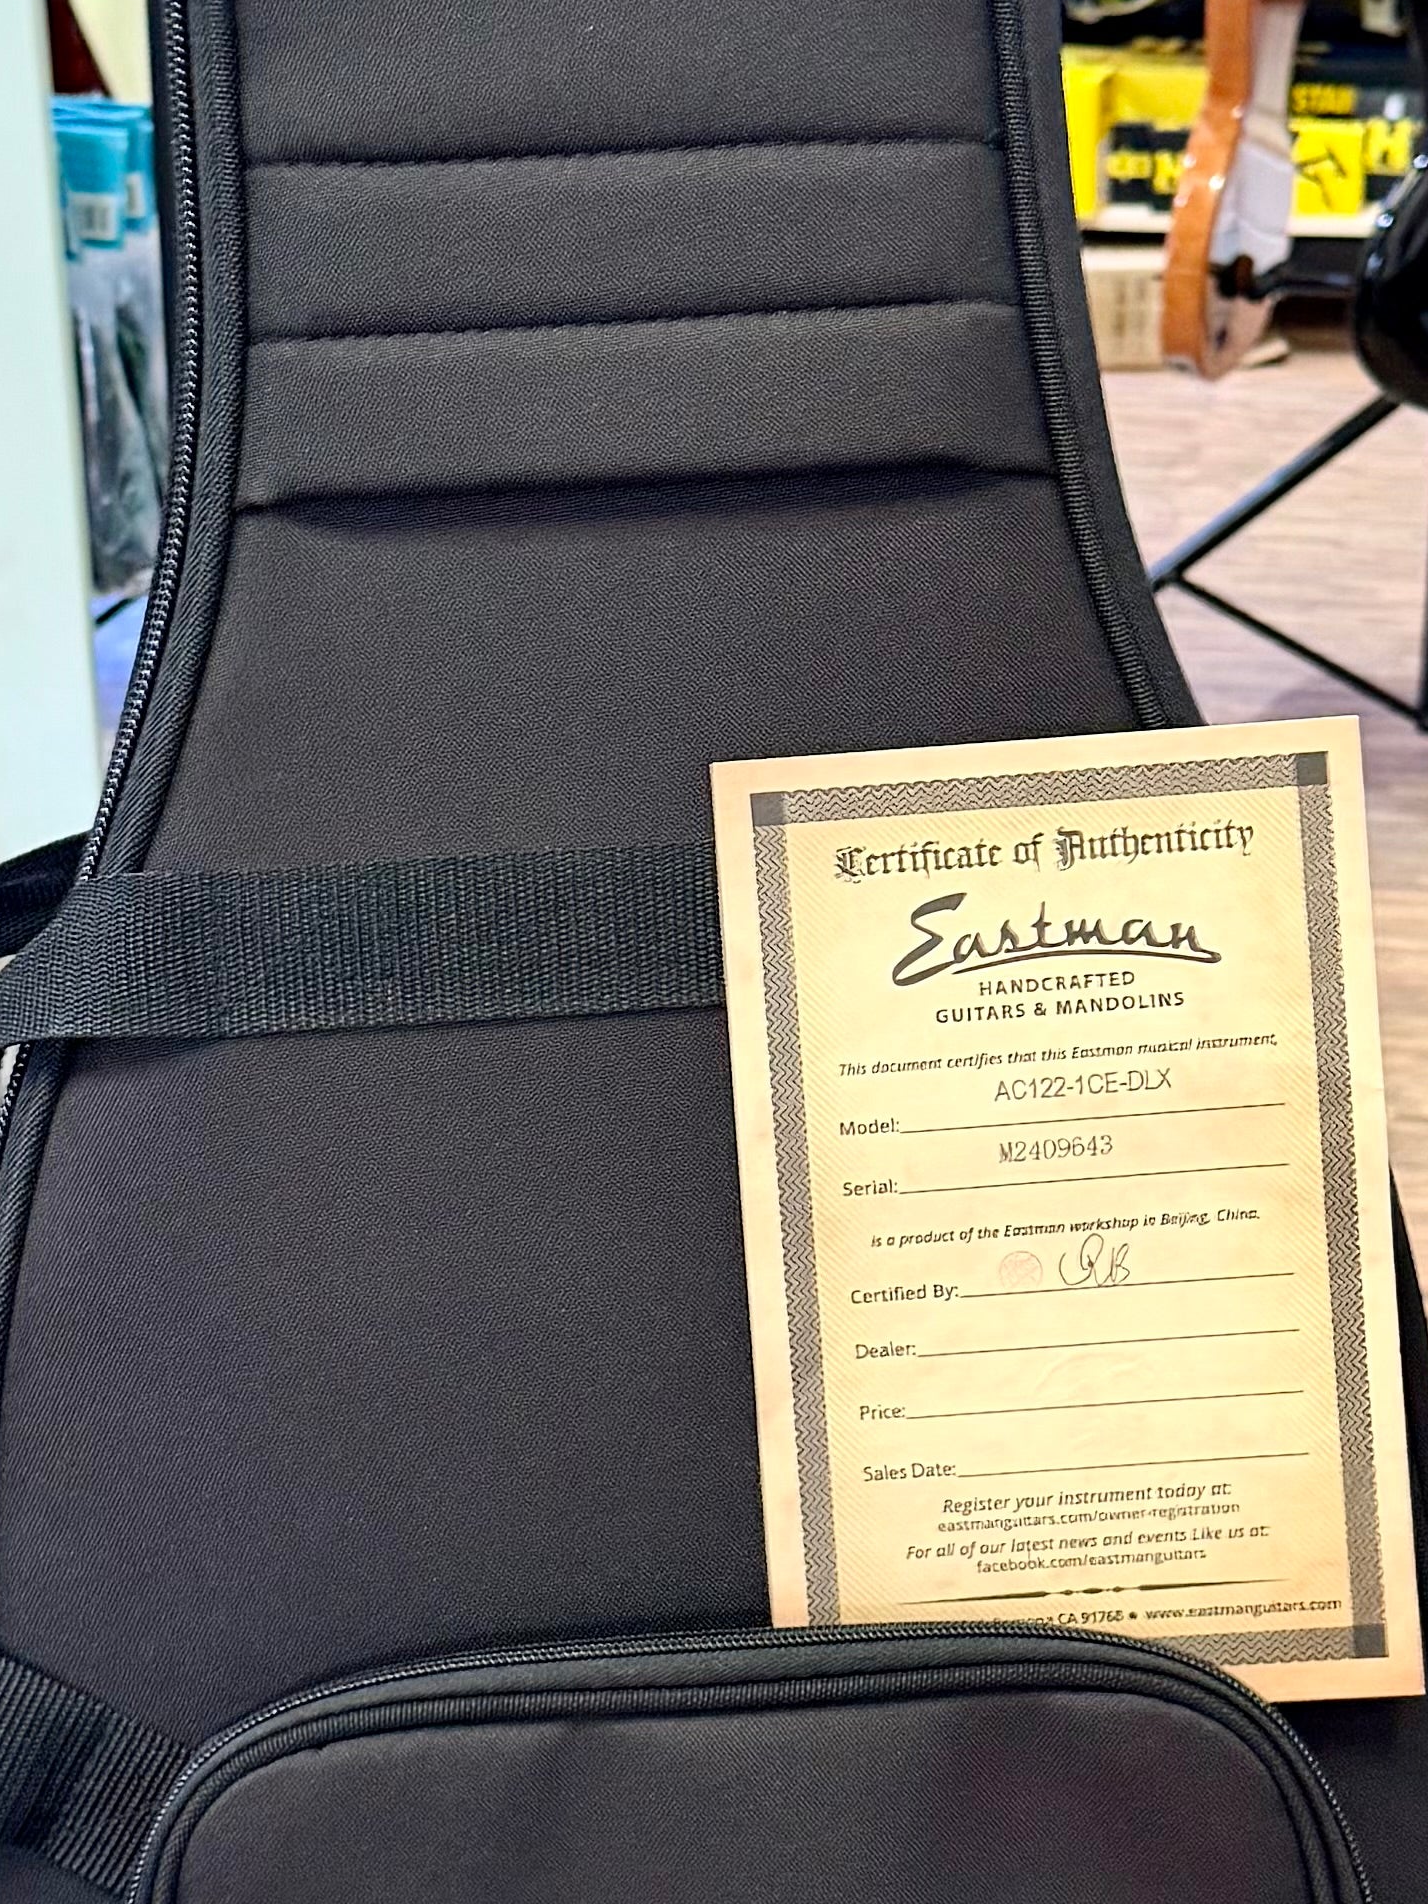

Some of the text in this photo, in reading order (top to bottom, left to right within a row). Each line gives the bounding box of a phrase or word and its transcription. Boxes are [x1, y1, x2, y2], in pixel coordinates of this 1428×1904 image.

[835, 819, 1255, 884] Certificate of Authenticity
[892, 892, 1222, 987] Eastman
[979, 971, 1135, 997] HANDCRAFTED
[936, 992, 1185, 1023] GUITARS & MANDOLINS
[838, 1062, 867, 1077] This
[871, 1058, 943, 1075] document
[947, 1053, 1004, 1071] certifies
[1008, 1051, 1037, 1065] that
[1041, 1048, 1067, 1062] this
[1071, 1044, 1133, 1059] Eastman
[1137, 1038, 1193, 1054] musical
[994, 1068, 1173, 1102] AC122-1CE-DLX
[839, 1117, 901, 1136] Model:
[998, 1134, 1114, 1164] M2409643
[843, 1179, 899, 1197] Serial:
[871, 1234, 883, 1248] is
[886, 1235, 895, 1246] a
[899, 1229, 955, 1249] product
[960, 1227, 975, 1244] of
[977, 1227, 1000, 1240] the
[1004, 1222, 1066, 1238] Eastman
[1069, 1218, 1139, 1233] workshop
[1143, 1214, 1156, 1227] in
[1217, 1208, 1261, 1223] China.
[851, 1283, 959, 1304] Certified By:
[855, 1341, 917, 1359] Dealer:
[860, 1404, 906, 1420] Price:
[863, 1462, 956, 1482] Sales Date:
[942, 1497, 1011, 1516] Register
[1013, 1495, 1054, 1514] your
[1058, 1487, 1153, 1506] instrument
[1157, 1482, 1206, 1502] today
[906, 1545, 932, 1560] For
[936, 1542, 955, 1558] all
[959, 1540, 976, 1560] of
[980, 1541, 1006, 1555] our
[1010, 1538, 1054, 1553] latest
[1059, 1535, 1098, 1548] news
[1102, 1530, 1134, 1548] and
[1138, 1528, 1187, 1545] events
[1192, 1525, 1223, 1542] Like
[1227, 1525, 1245, 1539] us
[977, 1547, 1208, 1574] facebook.com/eastmanguitars
[1057, 1612, 1078, 1626] CA
[1144, 1598, 1342, 1619] www.eastmanguitars.com
